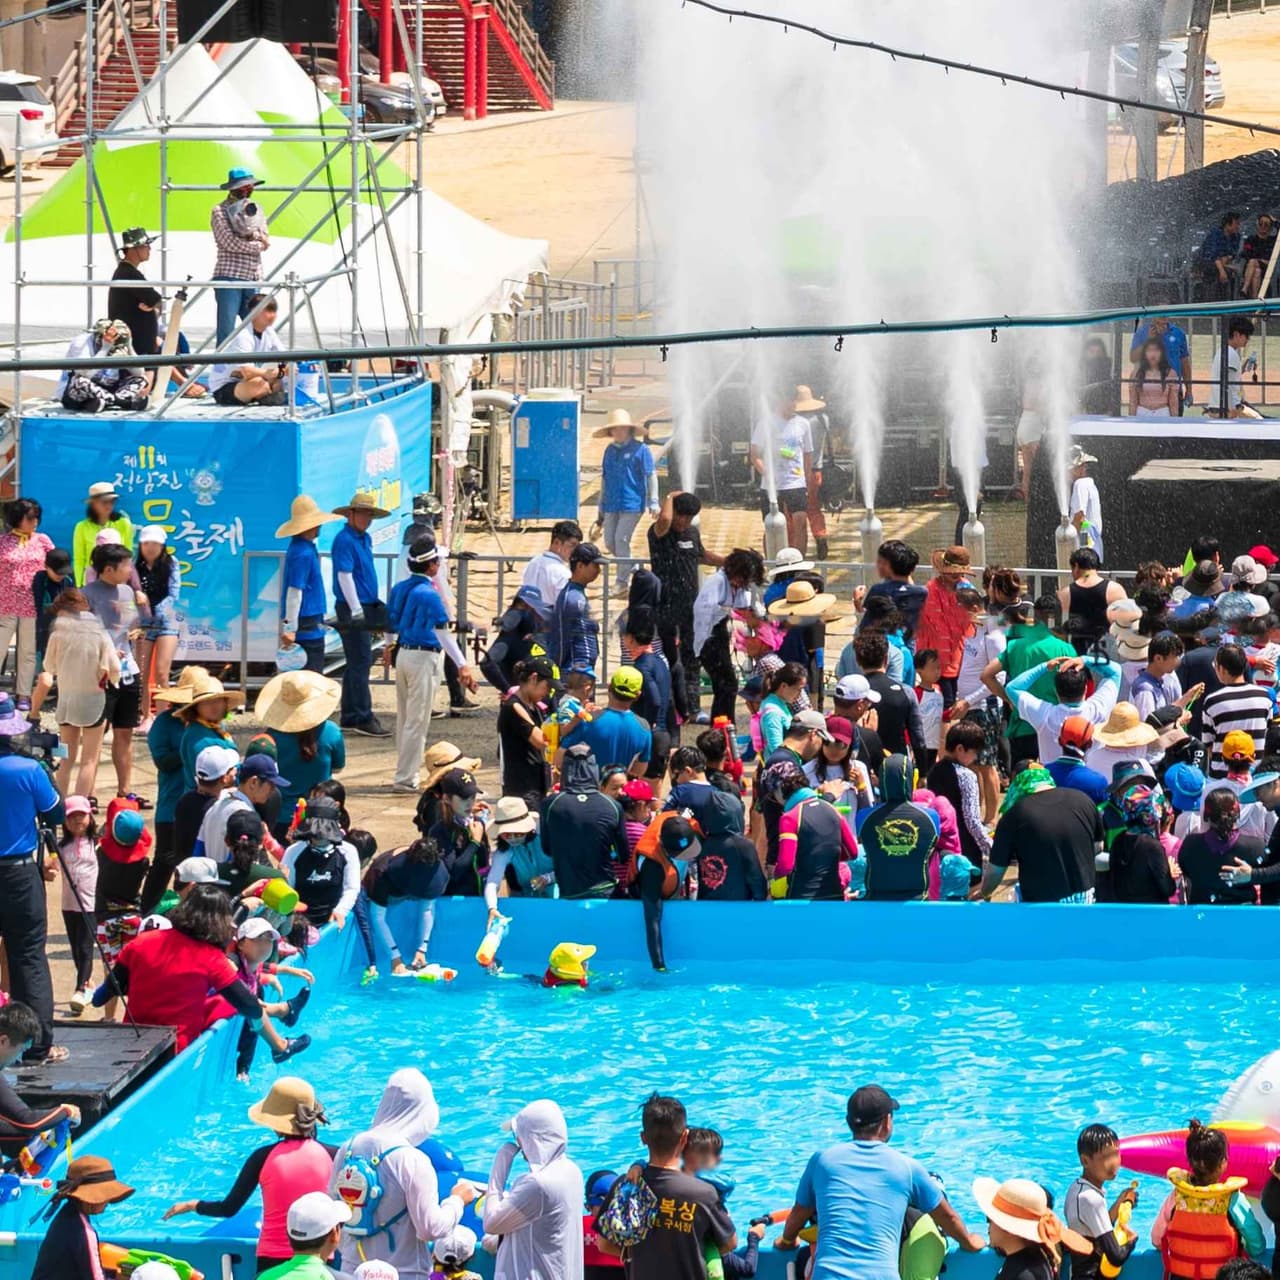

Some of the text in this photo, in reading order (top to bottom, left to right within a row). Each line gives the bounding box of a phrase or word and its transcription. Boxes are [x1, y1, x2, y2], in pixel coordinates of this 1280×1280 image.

[123, 444, 168, 470] 제11회
[112, 469, 183, 496] 정남진
[173, 508, 245, 561] 축제
